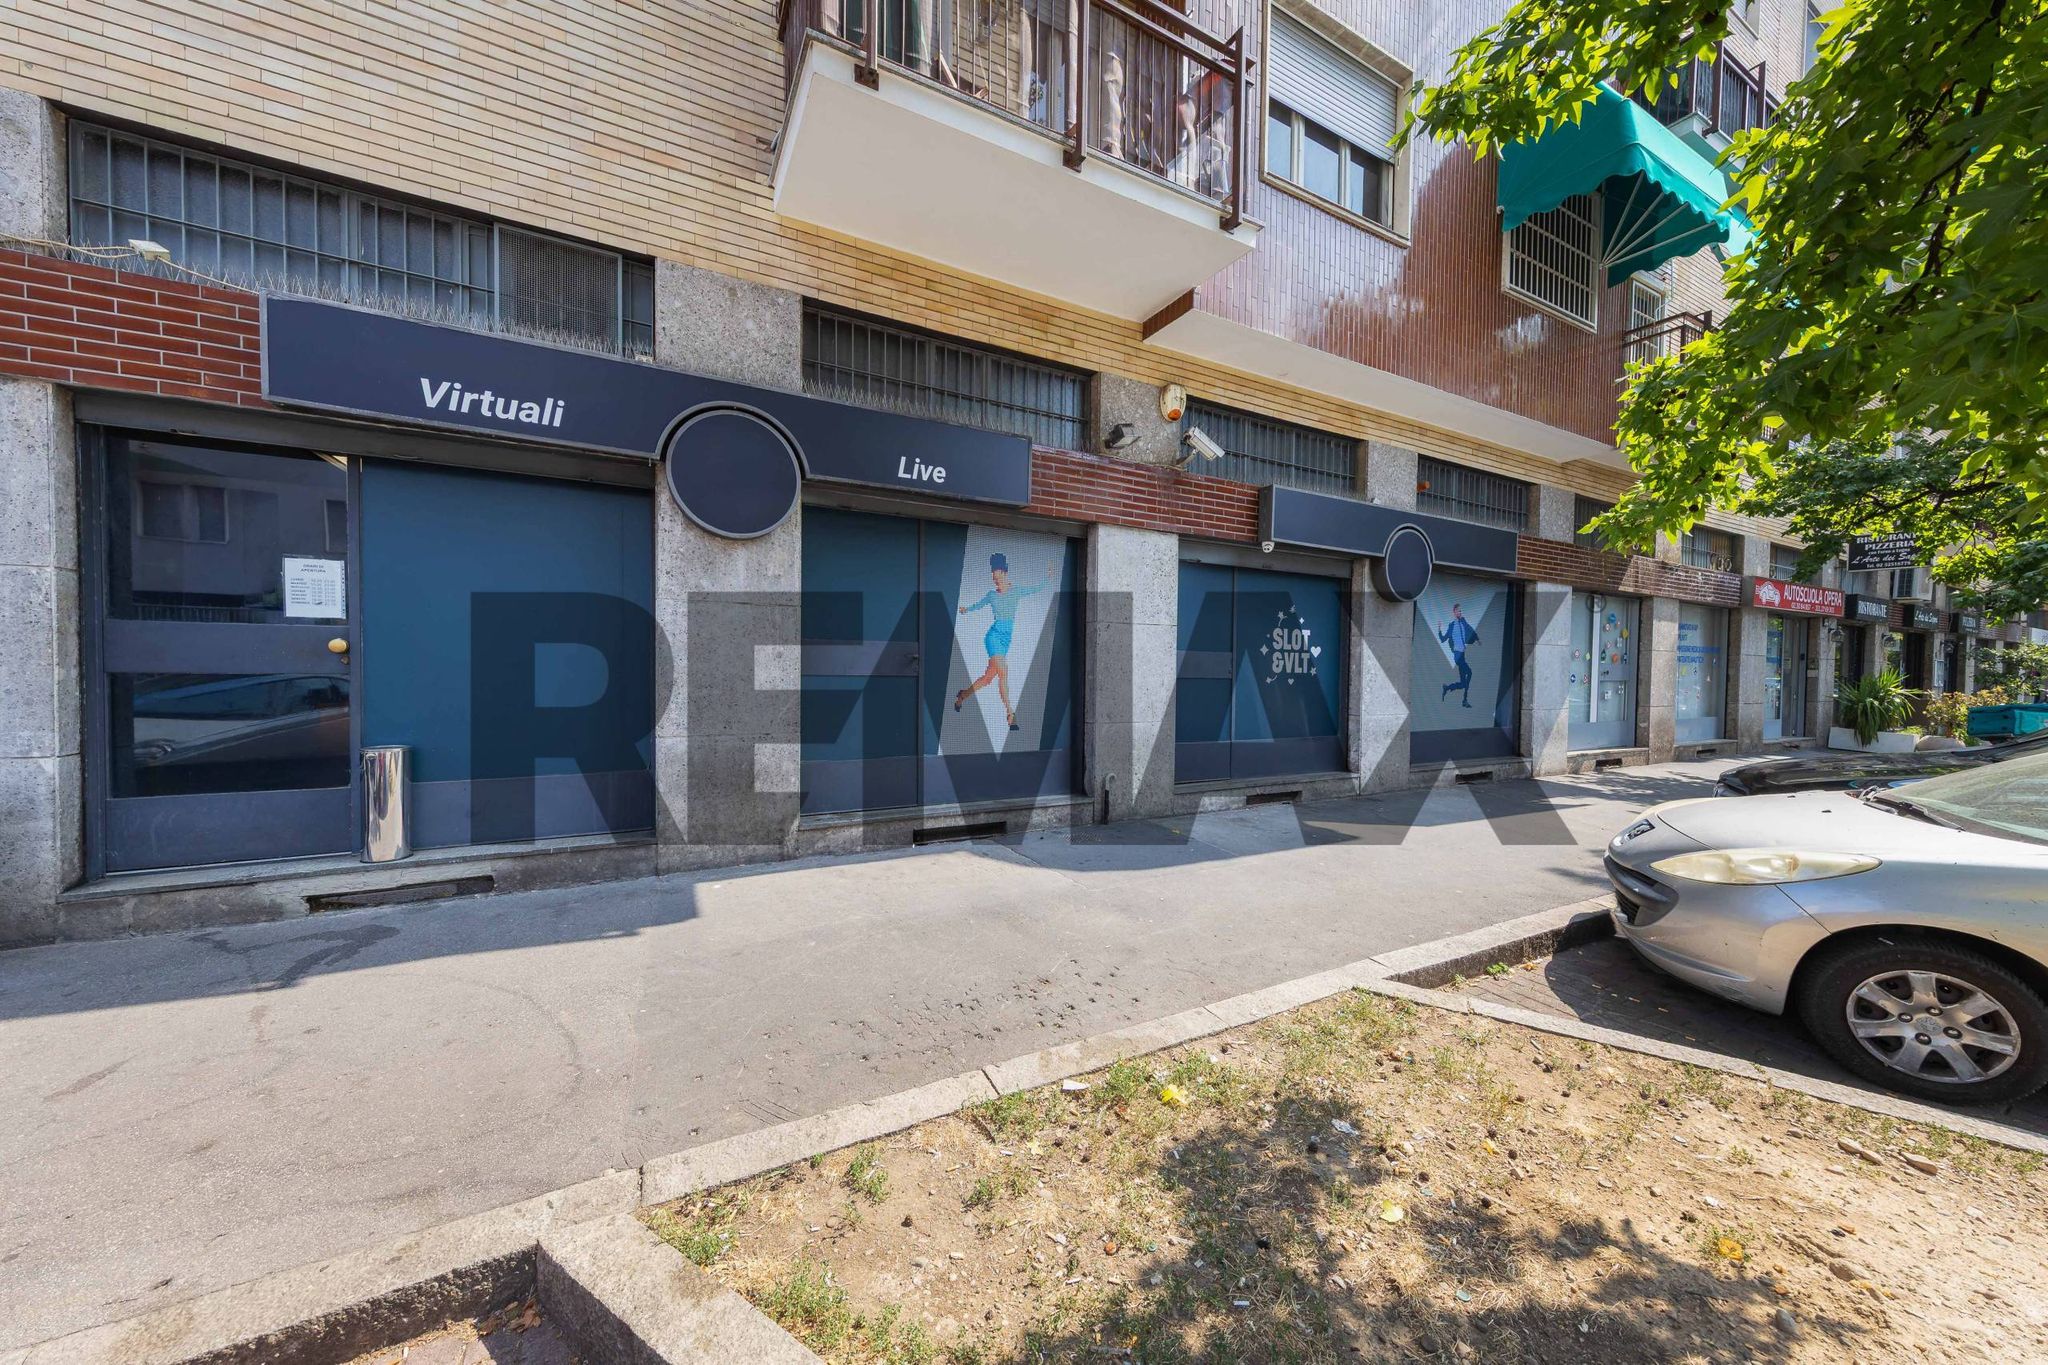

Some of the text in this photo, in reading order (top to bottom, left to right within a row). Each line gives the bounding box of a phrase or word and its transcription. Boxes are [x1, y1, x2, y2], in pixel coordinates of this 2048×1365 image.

[420, 377, 565, 427] Virtuali
[897, 455, 946, 484] Live
[1864, 540, 1915, 551] PIZZERIA
[1784, 584, 1823, 604] AUTOSCUOLA
[1824, 590, 1842, 606] OPERA
[1272, 627, 1311, 651] SLOT
[1272, 651, 1310, 673] &VLT
